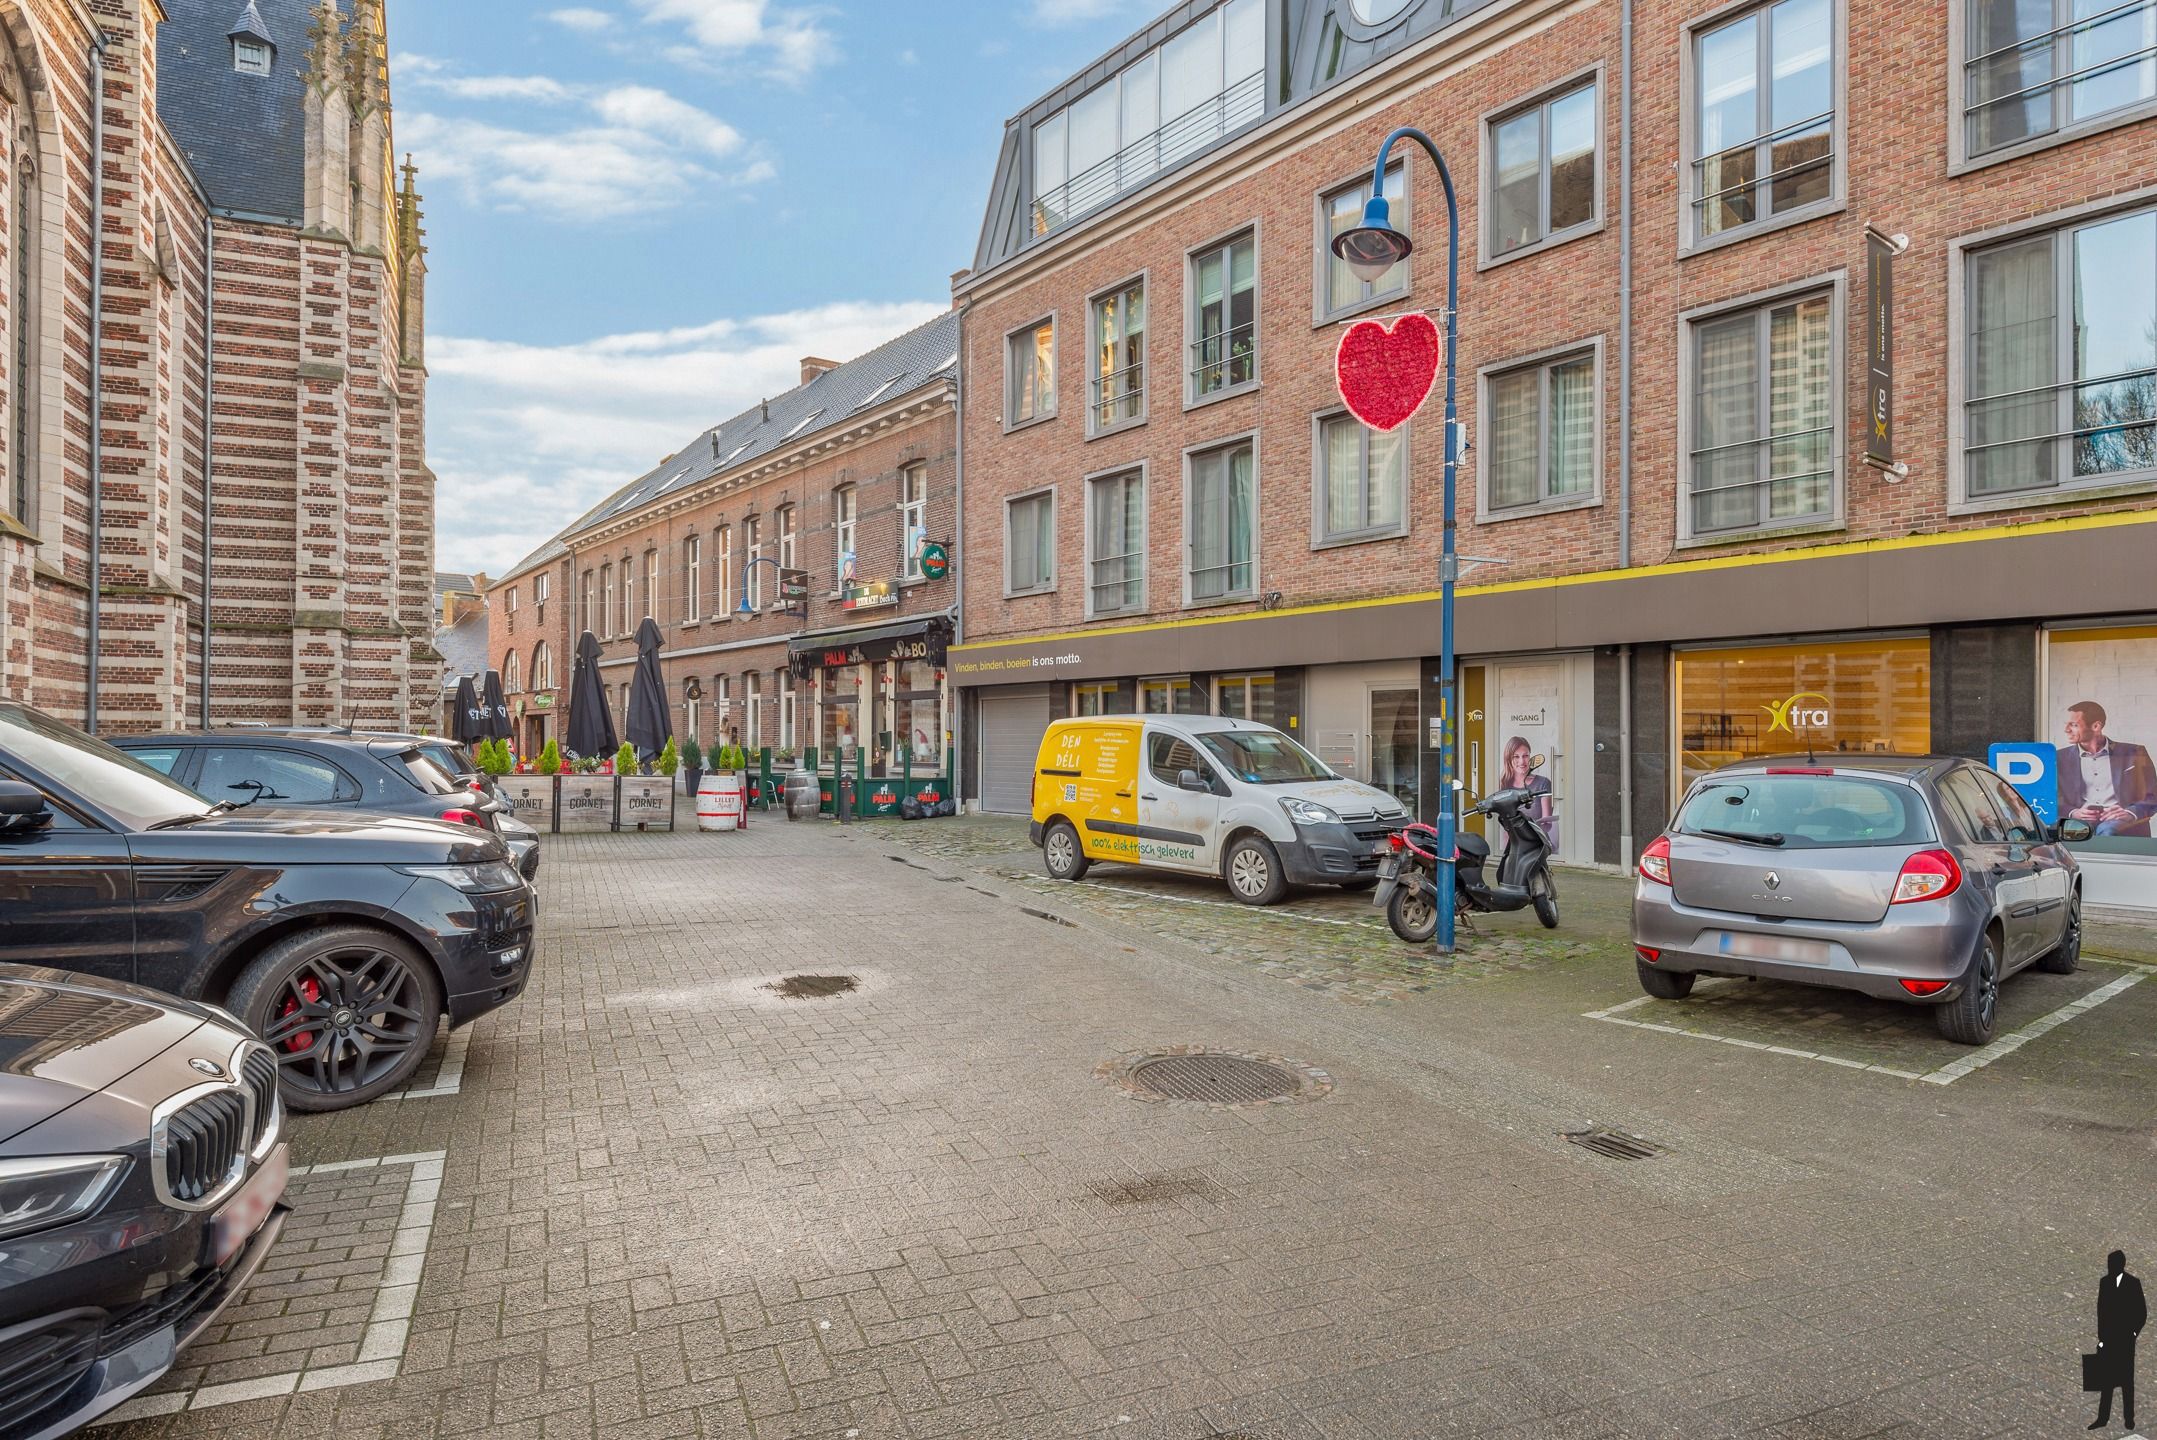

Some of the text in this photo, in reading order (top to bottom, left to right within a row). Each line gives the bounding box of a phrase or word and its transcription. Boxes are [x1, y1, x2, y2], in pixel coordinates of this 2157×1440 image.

[824, 650, 847, 665] PALM
[954, 652, 1082, 673] Vinden, binden, boeien is ons motto.
[1510, 714, 1540, 722] INGANG
[1061, 734, 1082, 748] DEN
[1055, 751, 1080, 768] DÉLI
[1996, 752, 2045, 785] P
[512, 798, 544, 810] ORNET
[569, 798, 605, 810] CORNET
[629, 798, 663, 810] CORNET
[872, 793, 896, 804] PALM
[1091, 838, 1196, 860] 100% elektrisch geleverd
[1751, 894, 1793, 903] CLIO
